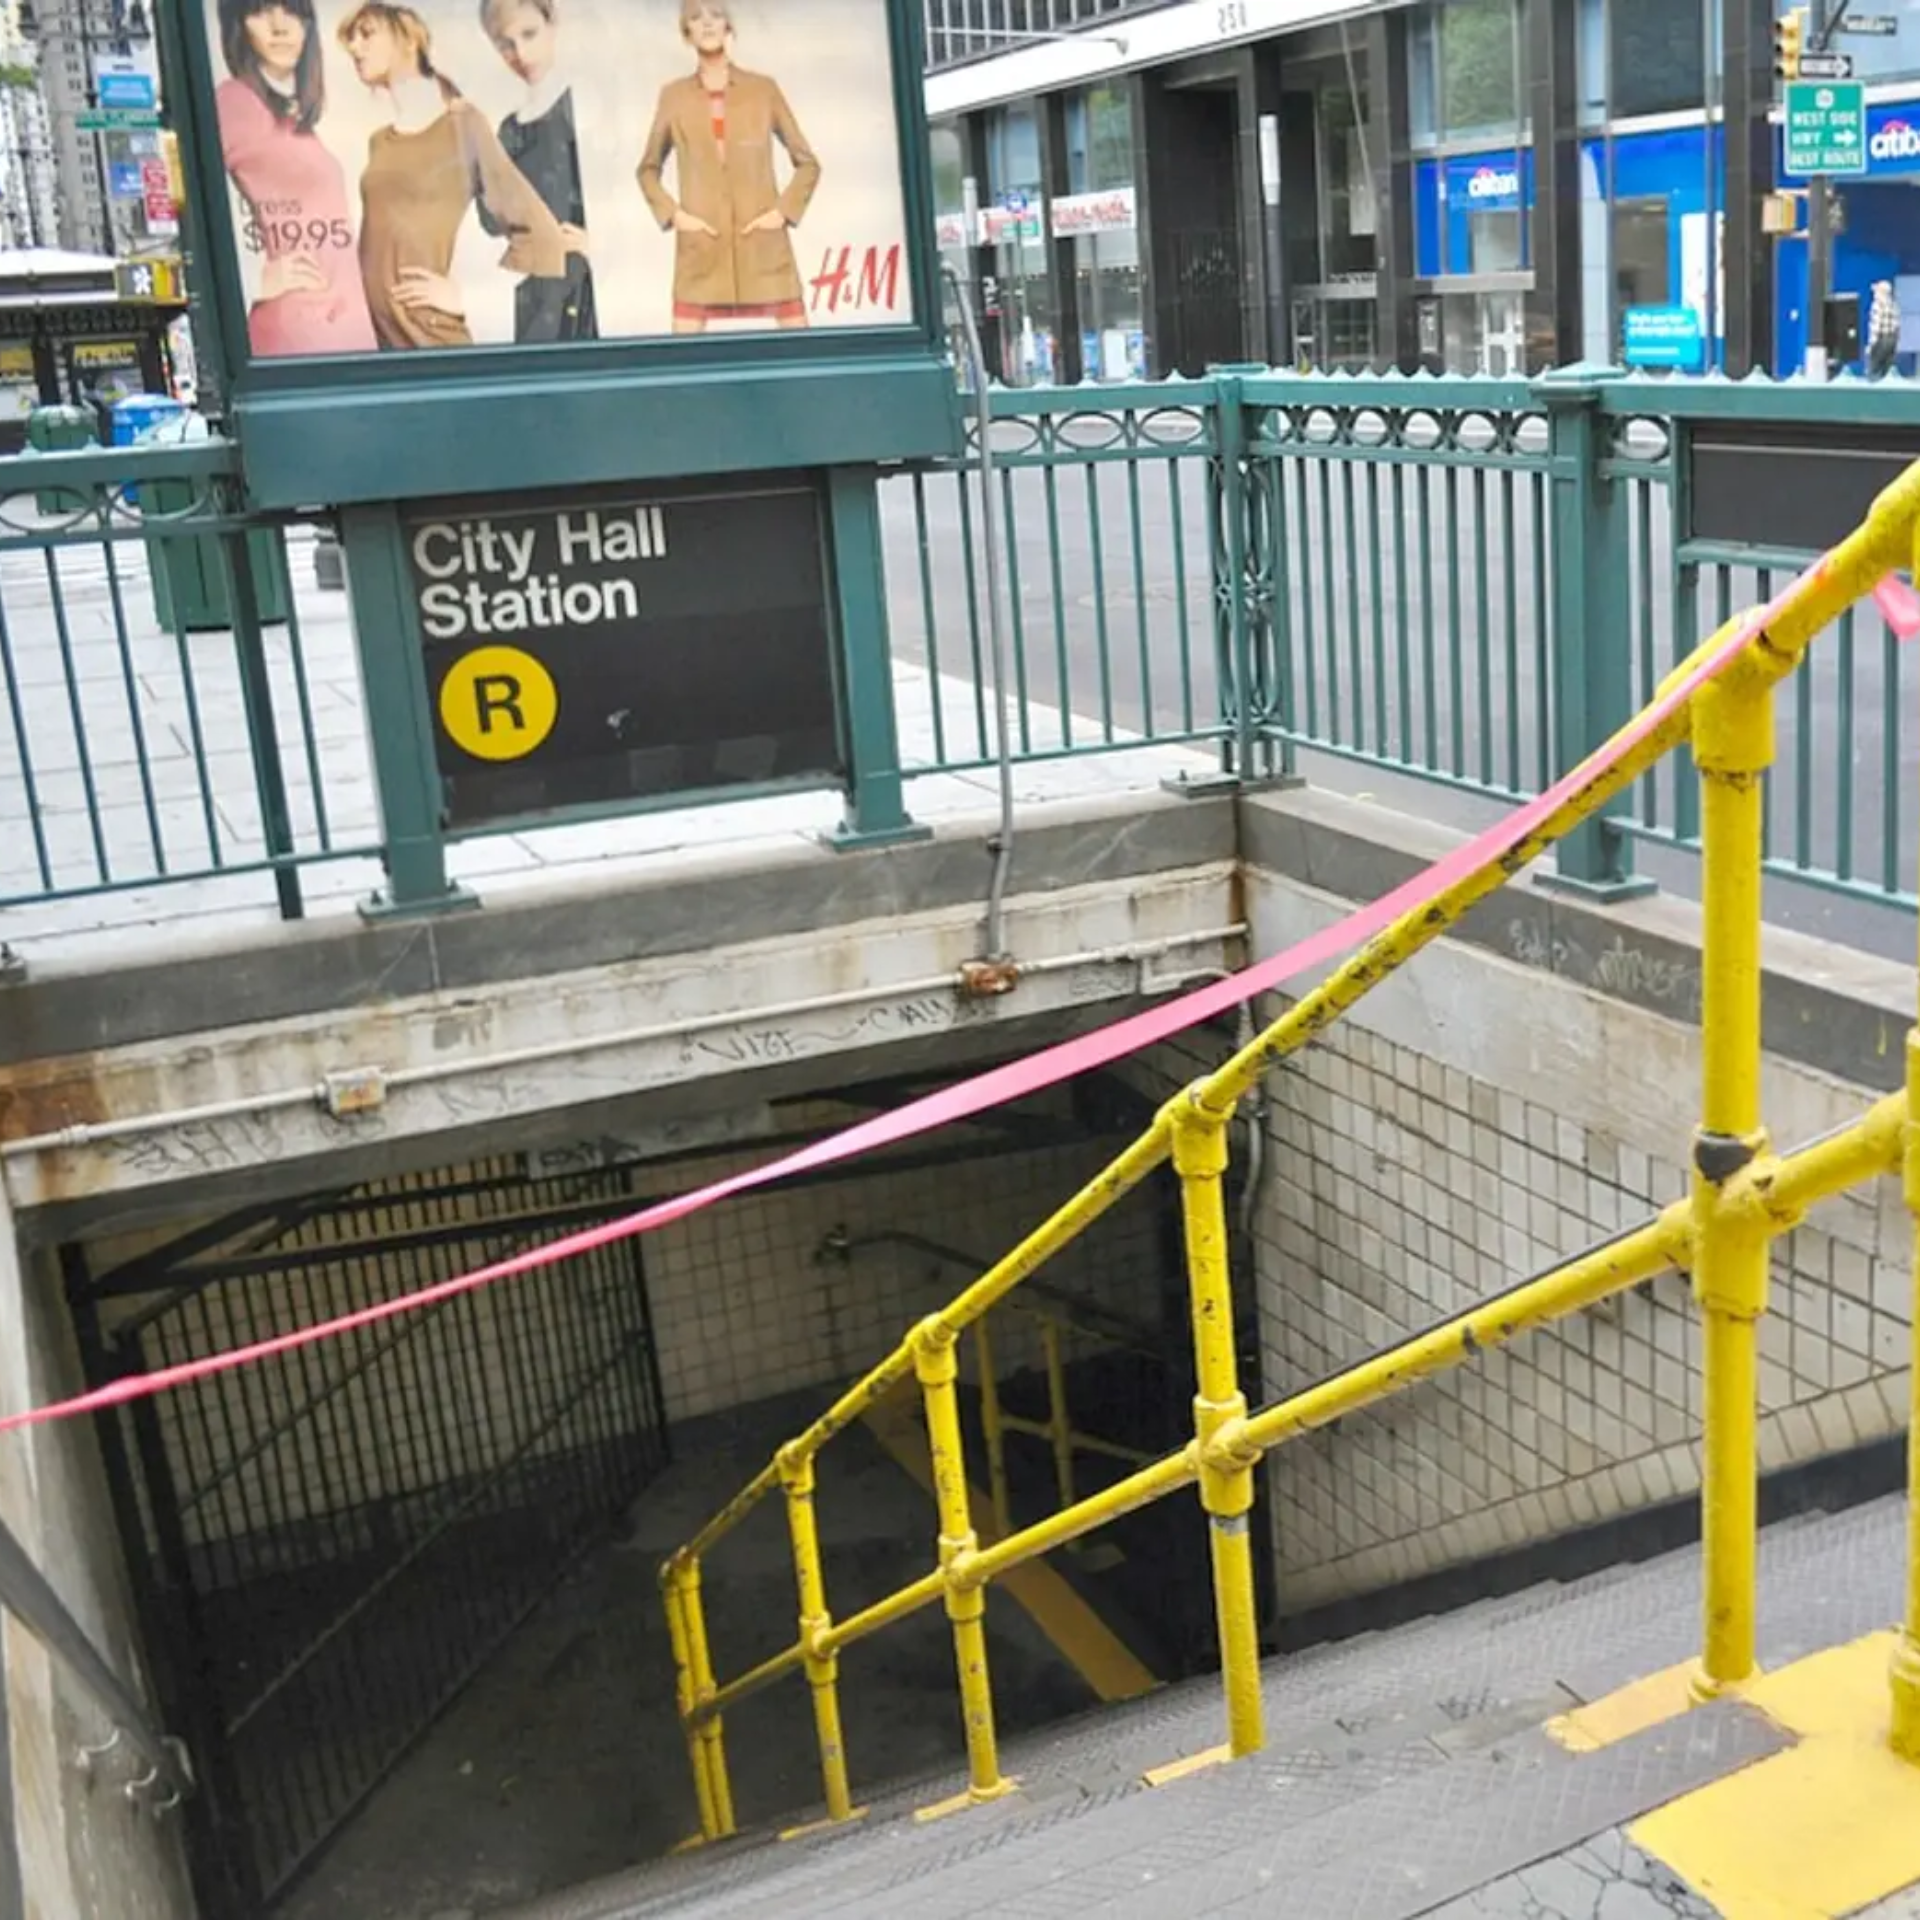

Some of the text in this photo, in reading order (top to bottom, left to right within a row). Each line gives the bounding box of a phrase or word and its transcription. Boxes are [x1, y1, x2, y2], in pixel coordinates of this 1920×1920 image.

[243, 219, 352, 254] $19.95
[413, 507, 667, 582] City Hall
[420, 574, 638, 638] Station
[473, 674, 526, 734] R
